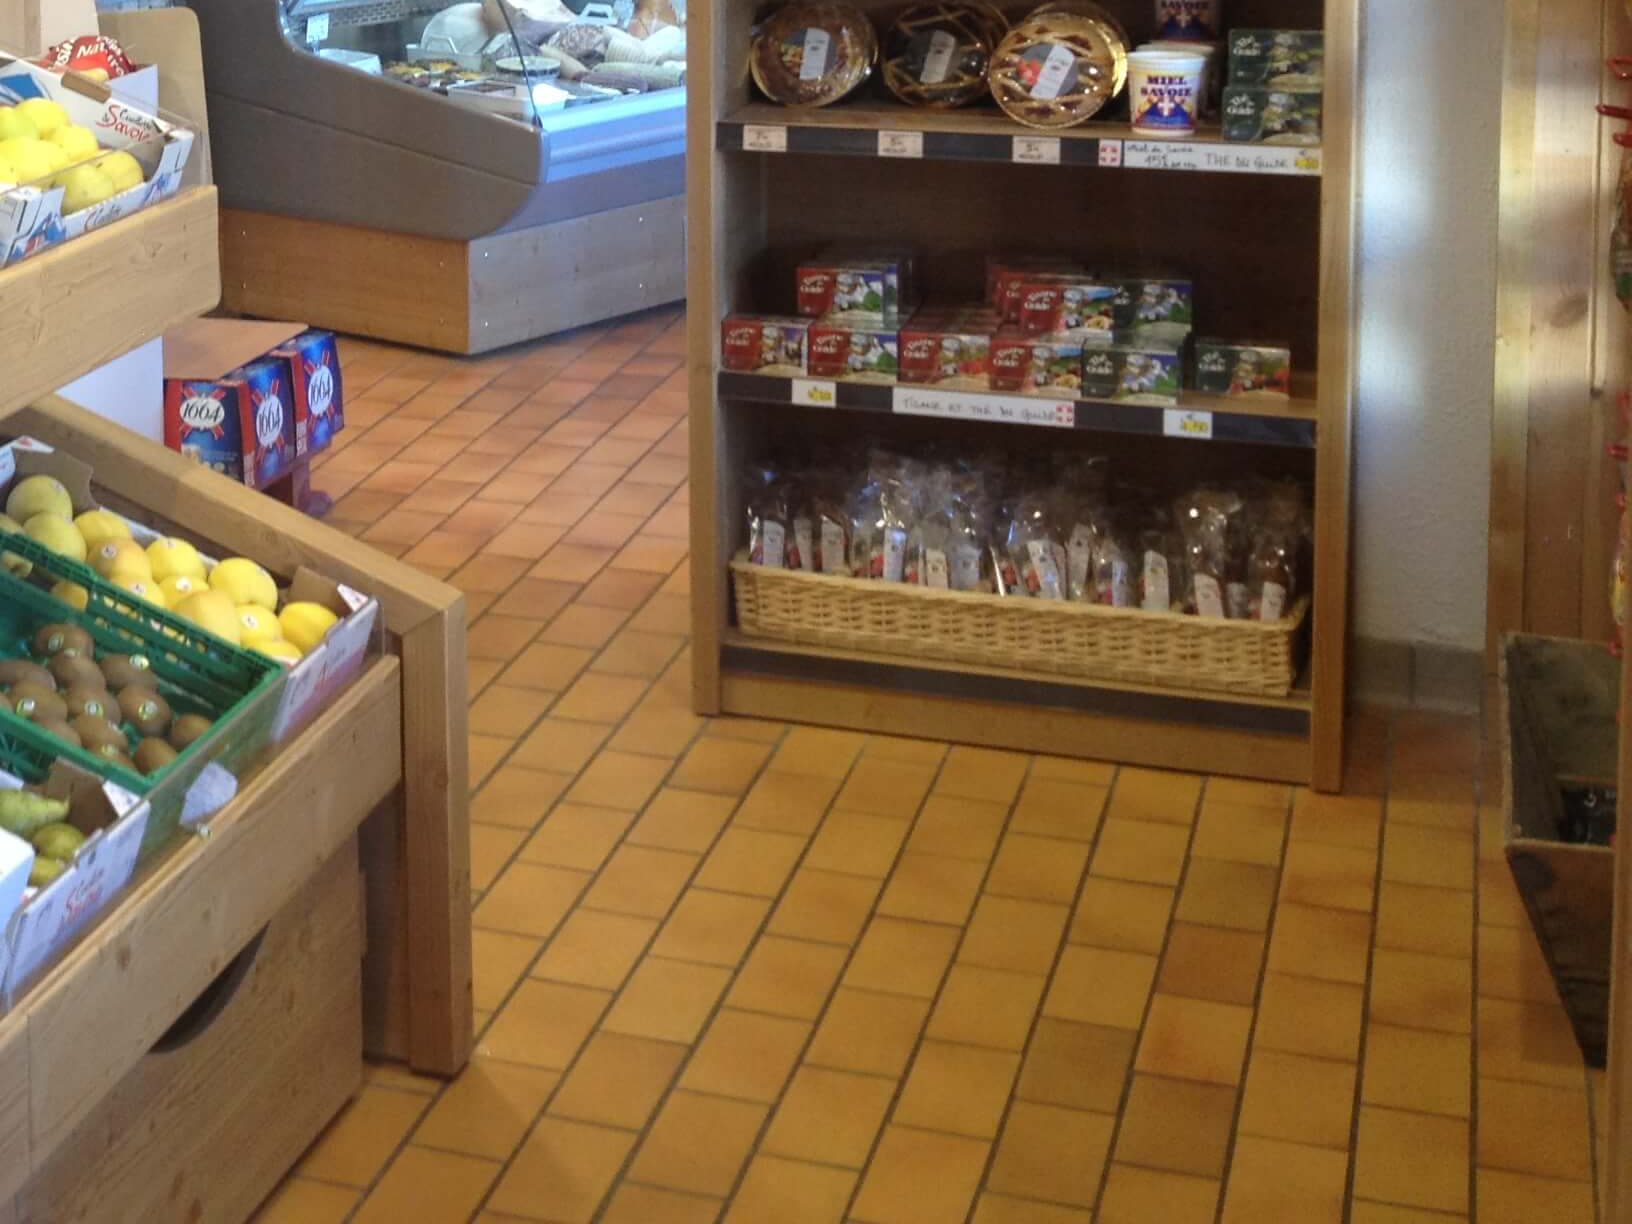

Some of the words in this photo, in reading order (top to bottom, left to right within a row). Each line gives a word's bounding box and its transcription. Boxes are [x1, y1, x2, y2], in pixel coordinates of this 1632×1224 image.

[1147, 76, 1188, 85] MIEL
[1140, 87, 1193, 97] SAVOIE
[310, 376, 333, 407] 1664
[182, 401, 223, 422] 1664
[258, 410, 282, 437] 1664
